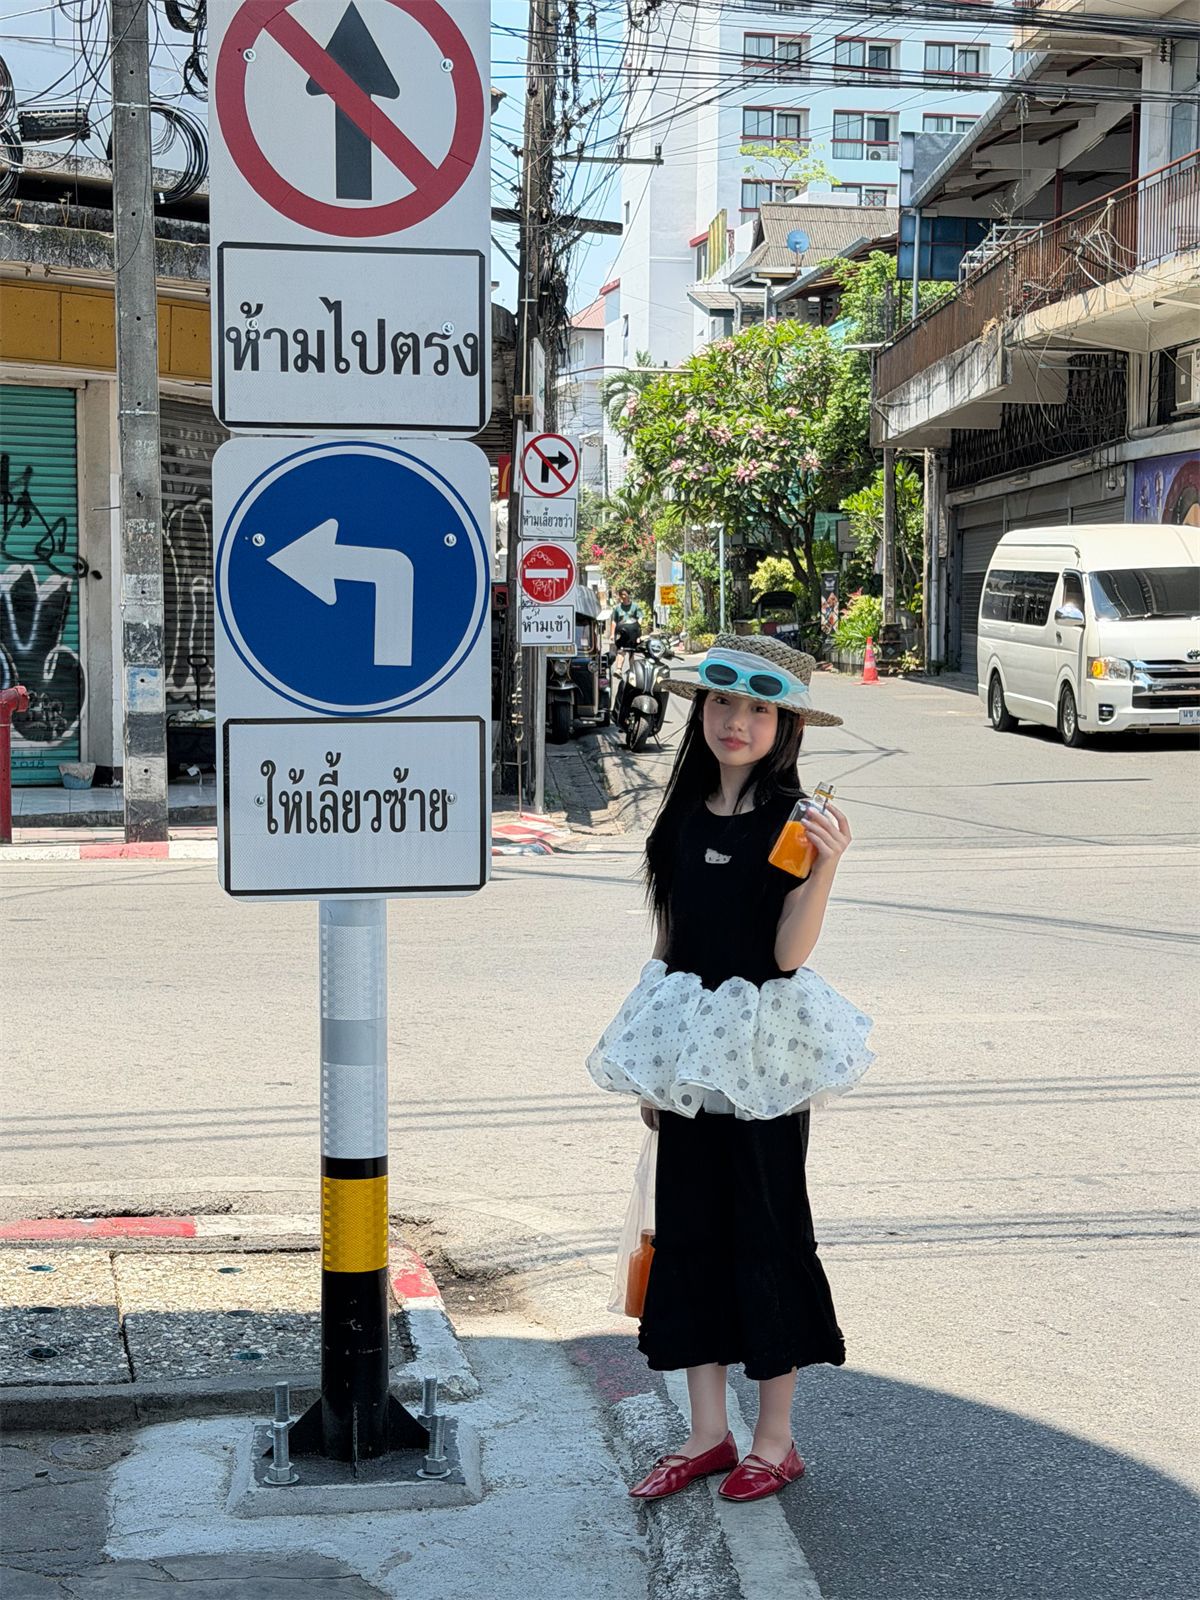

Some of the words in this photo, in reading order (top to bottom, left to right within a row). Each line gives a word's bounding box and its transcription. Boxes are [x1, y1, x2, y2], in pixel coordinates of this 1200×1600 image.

[225, 296, 479, 376] ห้ามไปตรง
[523, 507, 573, 528] ห้ามเลี้ยวขวา
[522, 615, 570, 632] ห้ามเข้า
[260, 751, 448, 834] ให้เลี้ยวซ้าย
